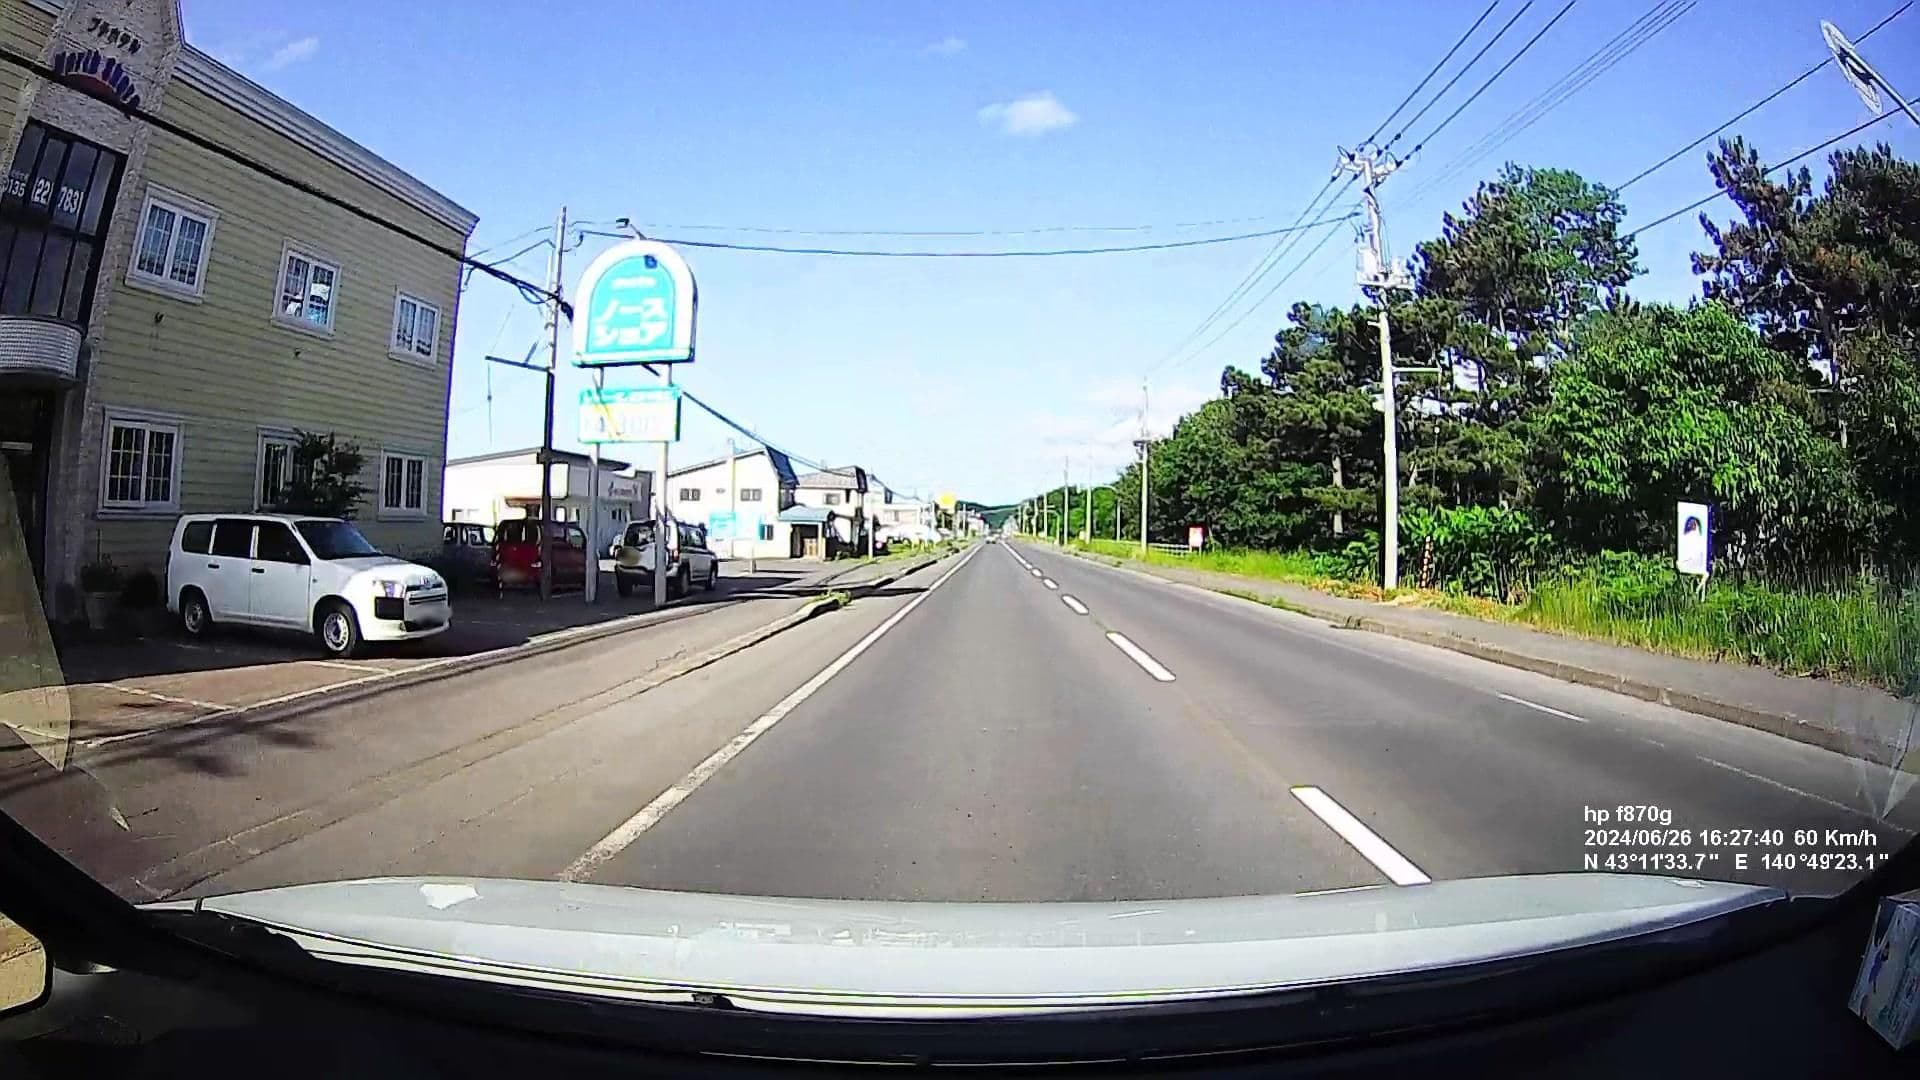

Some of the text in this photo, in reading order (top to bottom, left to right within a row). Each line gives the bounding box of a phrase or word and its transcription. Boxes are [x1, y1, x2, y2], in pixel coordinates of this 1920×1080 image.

[592, 297, 668, 322] ノース
[593, 321, 668, 347] ショア
